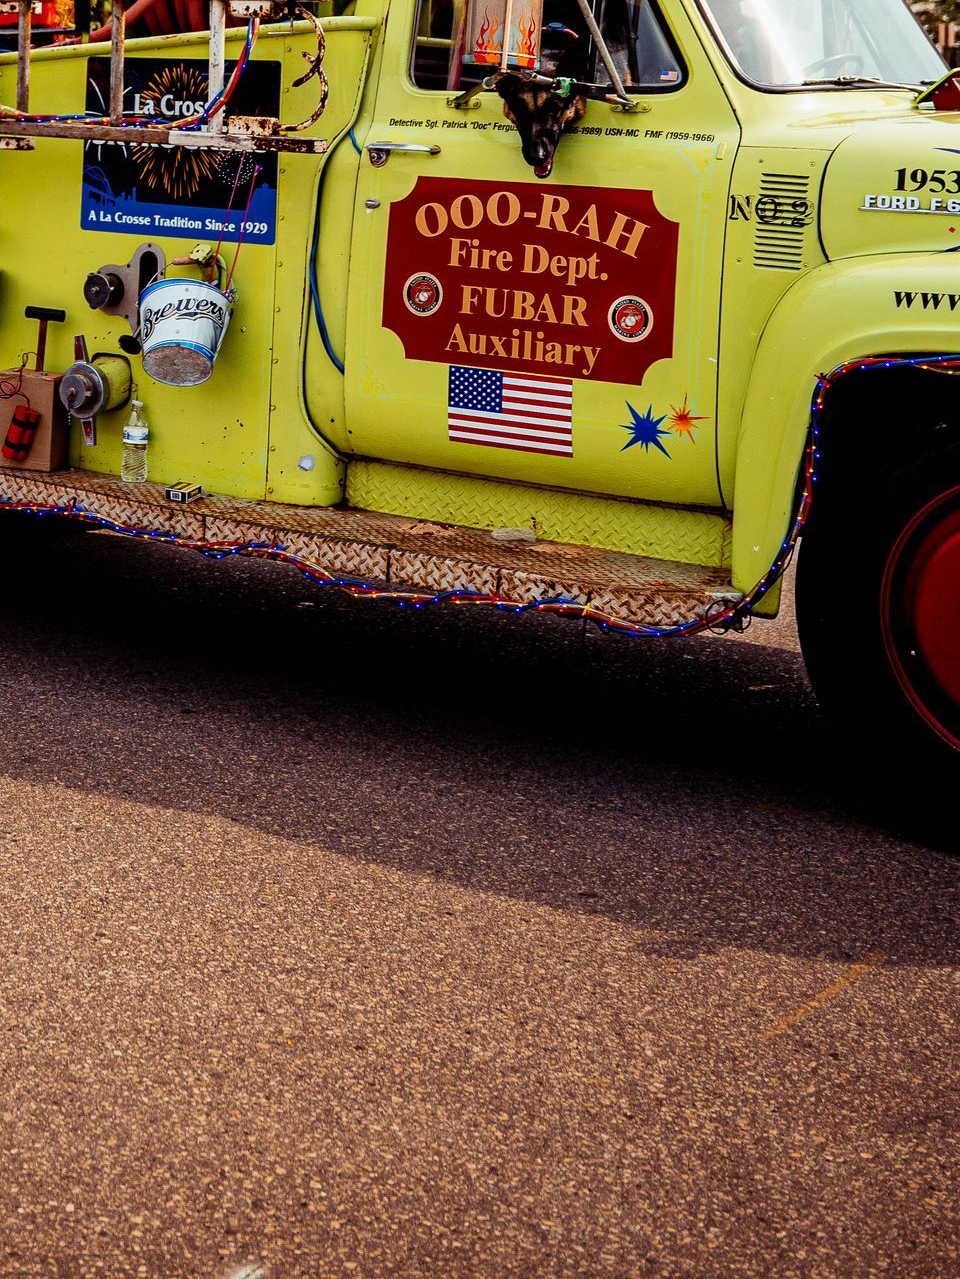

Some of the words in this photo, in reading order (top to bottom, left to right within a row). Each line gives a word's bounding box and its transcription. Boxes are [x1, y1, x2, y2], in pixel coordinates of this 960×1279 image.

[134, 93, 156, 115] La
[161, 94, 227, 116] Cros
[389, 118, 423, 128] Detective
[425, 119, 439, 130] Sgt.
[442, 120, 468, 130] Patrick
[470, 121, 491, 130] "Doc"
[604, 127, 640, 138] USN-MC
[644, 130, 664, 140] FMF
[665, 131, 715, 143] (1959-1966)
[893, 168, 960, 194] 1953
[864, 194, 920, 211] FORD
[88, 210, 96, 221] A
[99, 210, 112, 223] La
[114, 212, 151, 226] Crosse
[153, 214, 202, 230] Tradition
[205, 218, 236, 232] Since
[239, 222, 268, 234] 1929
[415, 191, 651, 259] OOO-RAH
[447, 237, 513, 272] Fire
[520, 243, 609, 286] Dept.
[458, 284, 589, 327] FUBAR
[444, 323, 602, 376] Auxiliary
